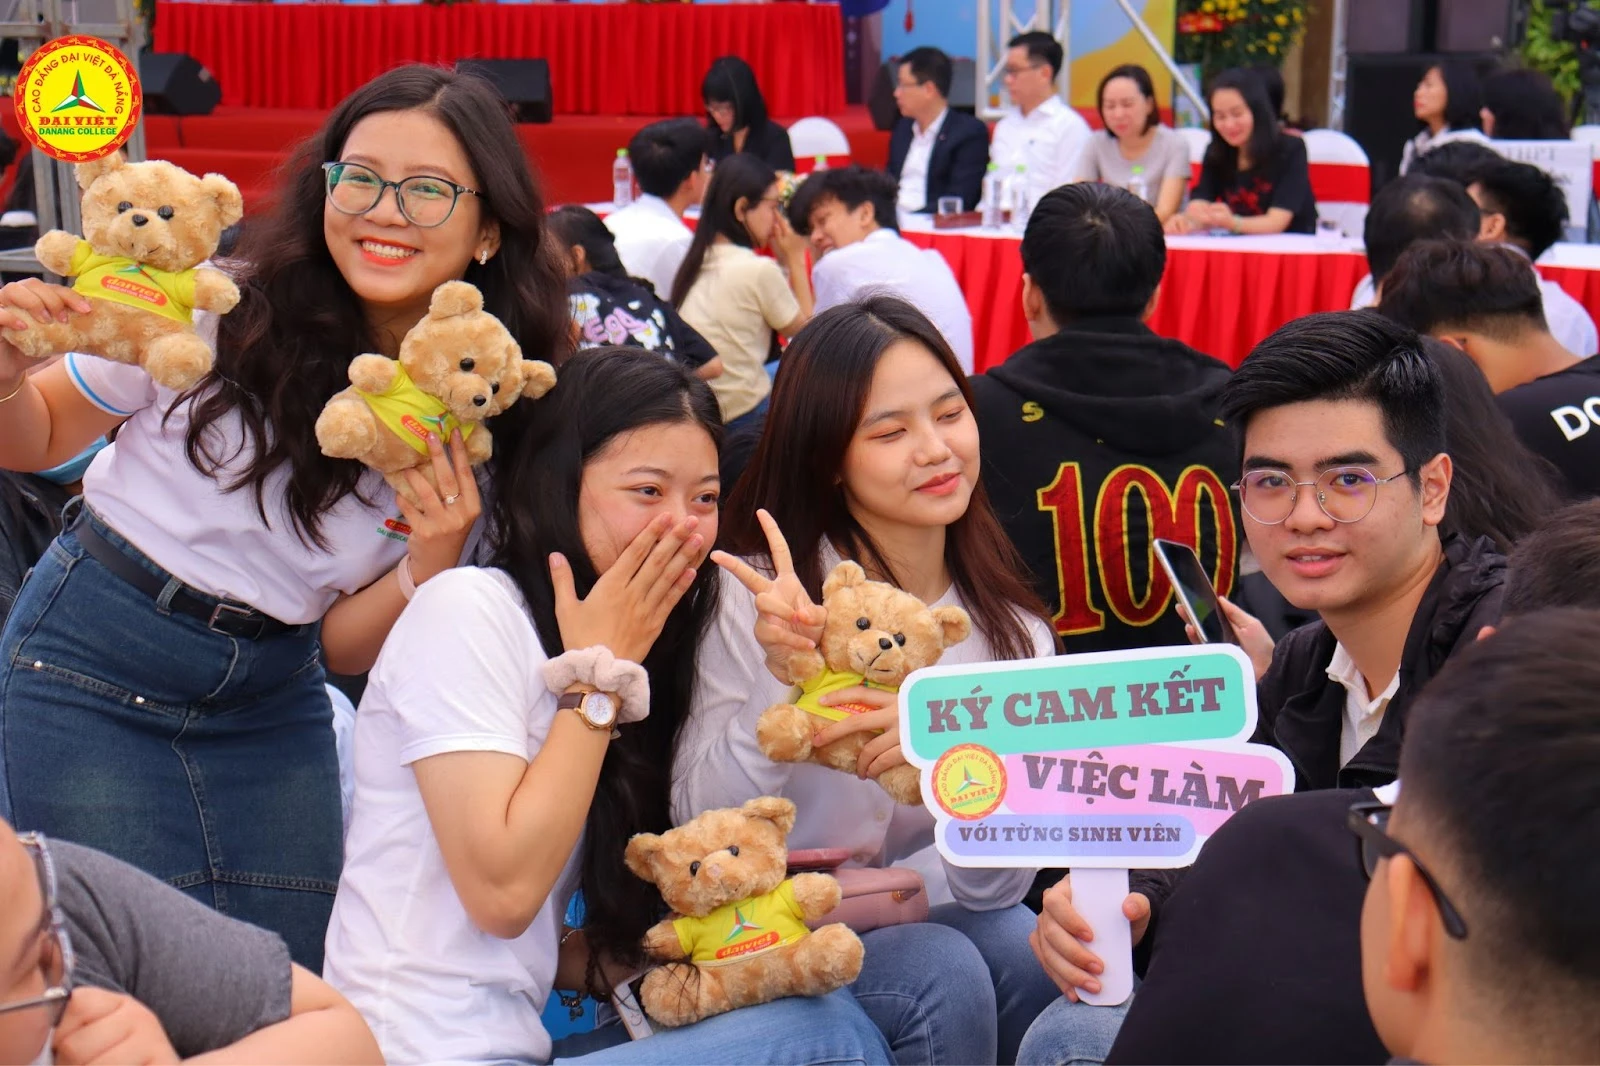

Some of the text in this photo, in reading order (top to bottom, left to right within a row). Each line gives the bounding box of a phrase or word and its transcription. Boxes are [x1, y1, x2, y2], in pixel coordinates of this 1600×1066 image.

[926, 664, 1226, 734] KÝ CAM KẾT
[1022, 751, 1265, 812] VIỆC LÀM
[958, 822, 1181, 842] VỚI TỪNG SINH VIÊN
